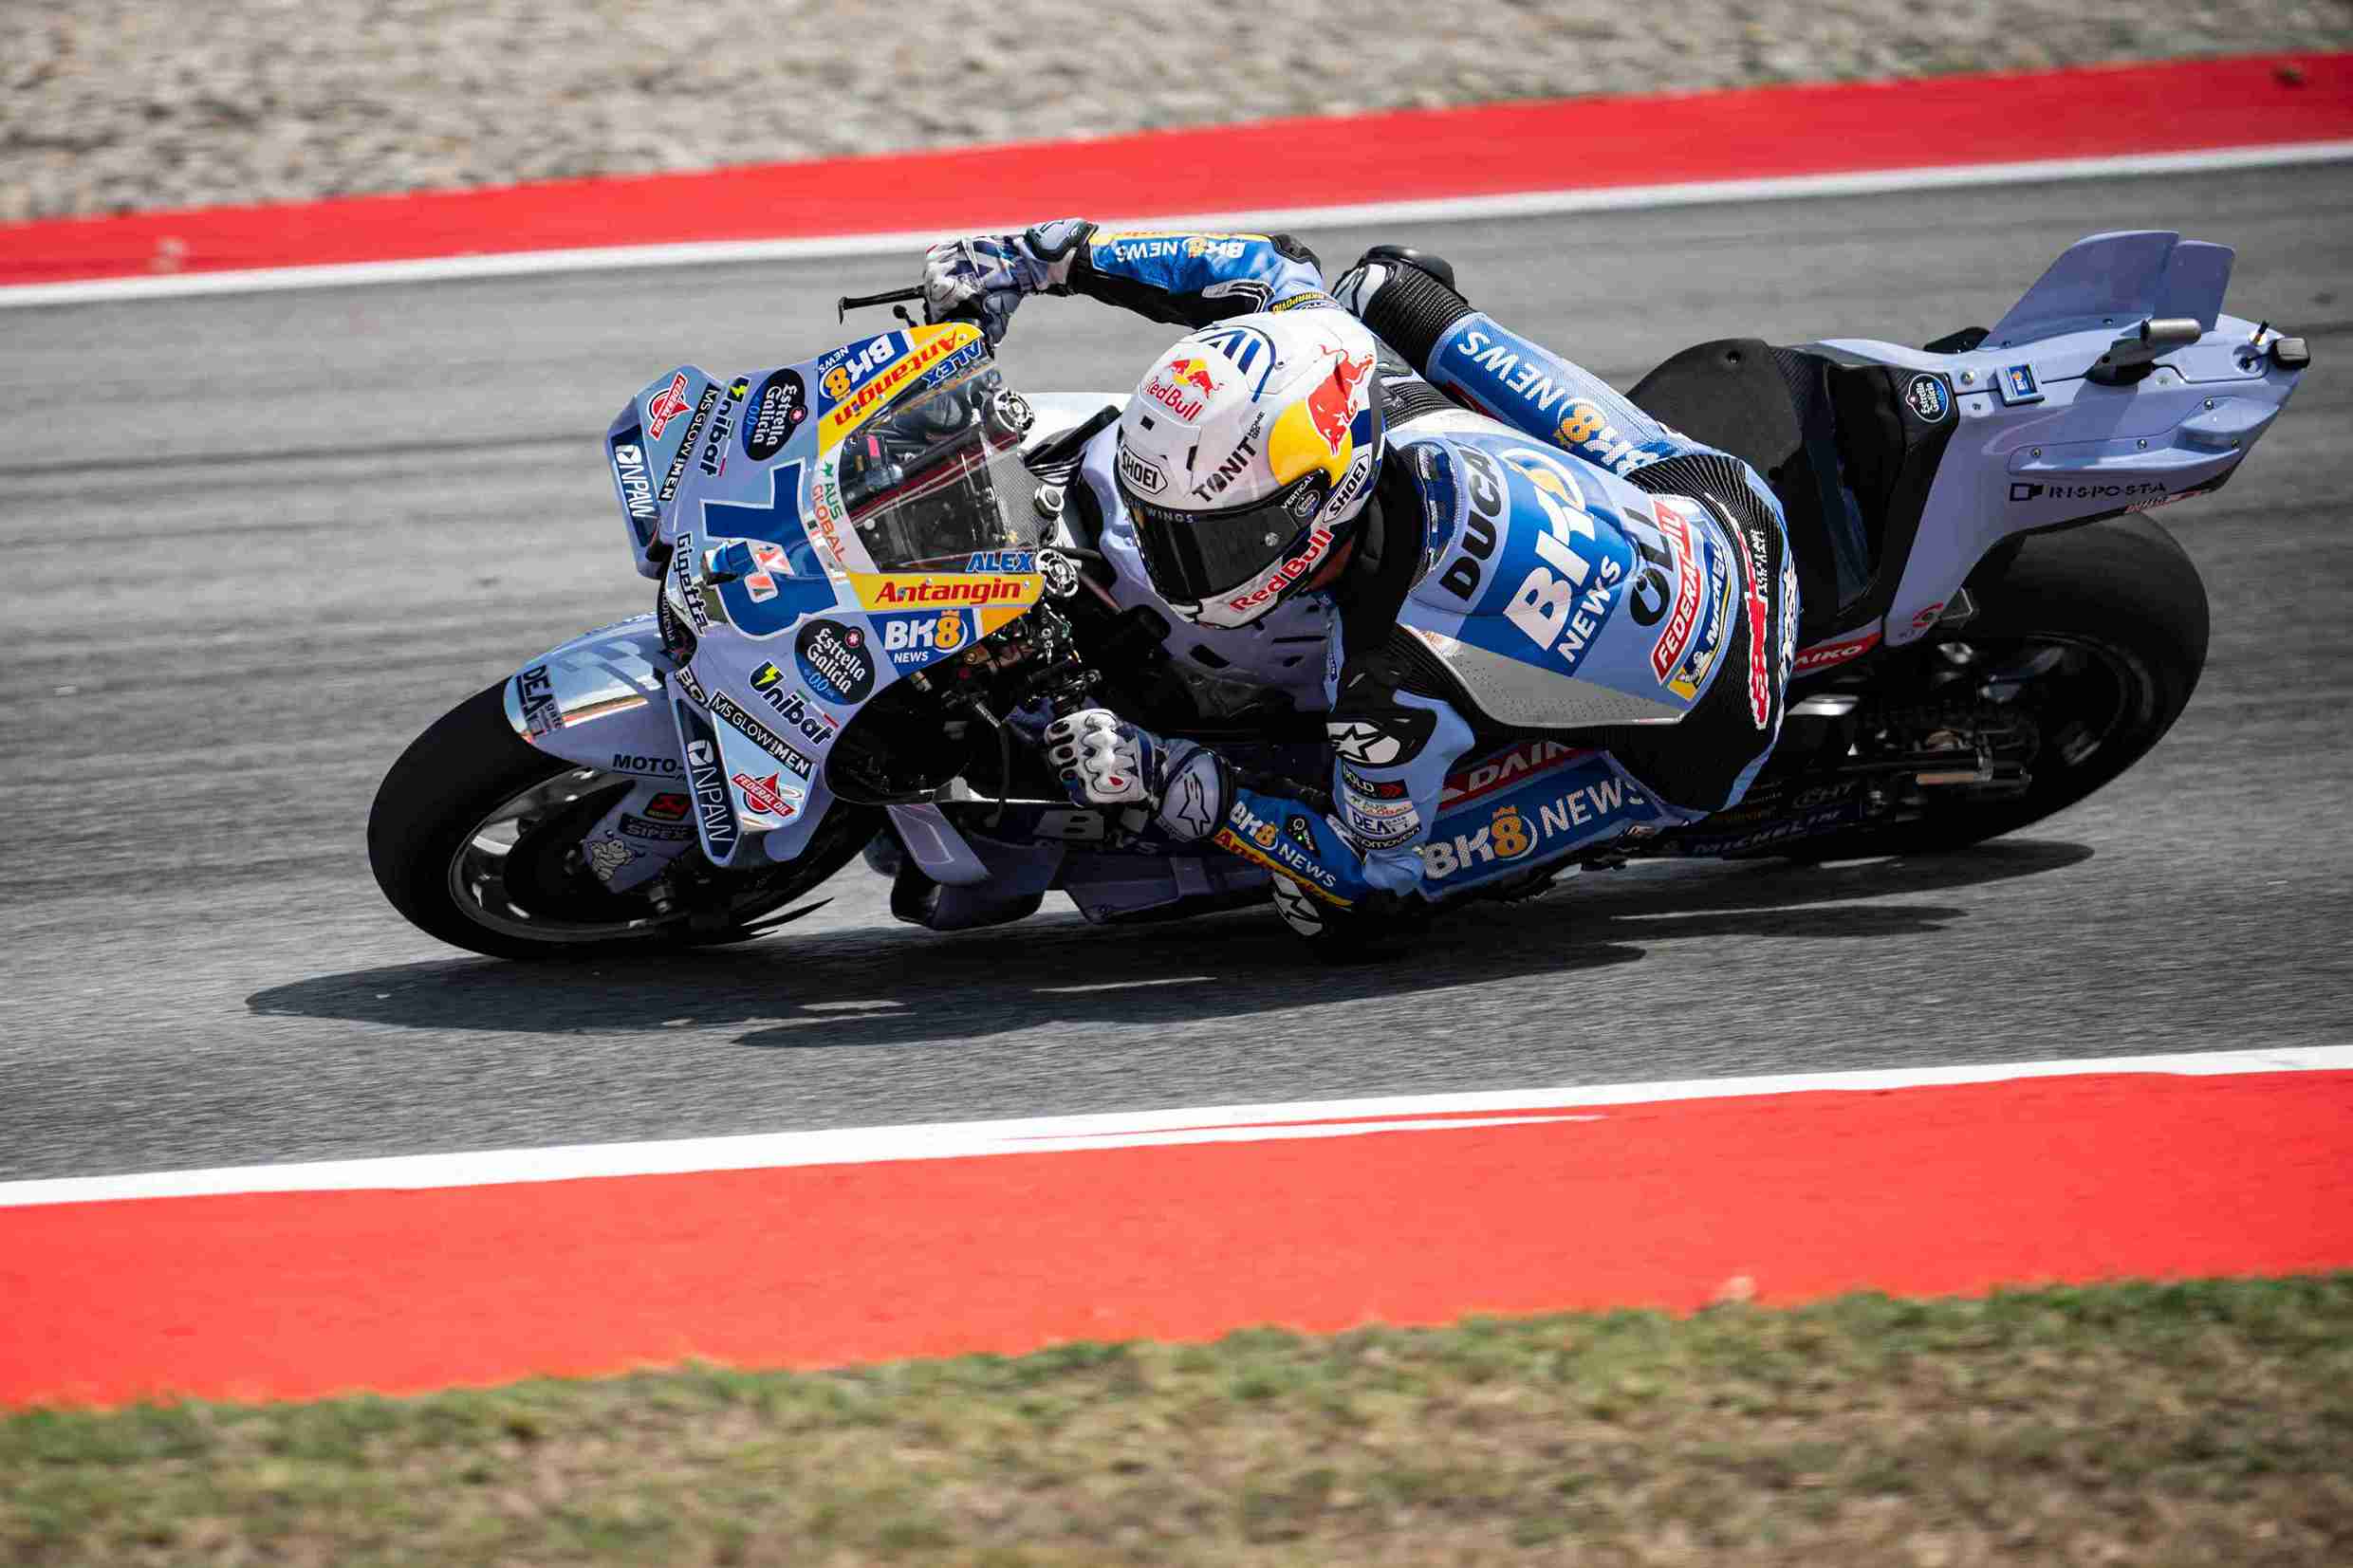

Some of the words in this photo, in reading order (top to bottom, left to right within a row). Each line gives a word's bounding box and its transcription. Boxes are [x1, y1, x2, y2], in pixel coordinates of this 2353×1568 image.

[1116, 242, 1177, 262] NEWS
[820, 346, 849, 373] NEWS
[824, 335, 896, 398] BK8
[834, 331, 957, 426] Antangin
[922, 341, 982, 389] ALEX
[1457, 332, 1565, 412] NEWS
[700, 389, 718, 412] MS
[752, 386, 783, 444] Galicia
[767, 383, 798, 447] Estrella
[1162, 388, 1202, 421] Bull
[682, 412, 703, 458] GLOW
[621, 463, 655, 519] NPAW
[661, 462, 685, 500] MEN
[1121, 451, 1158, 490] SHOEI
[1329, 460, 1368, 516] SHOEI
[2048, 481, 2167, 500] RISPOSTA
[824, 482, 843, 522] AUS
[673, 531, 710, 637] Gigetta
[966, 551, 1036, 574] ALEX
[1230, 572, 1288, 612] Red
[1281, 527, 1334, 580] Bull
[875, 578, 1022, 605] Antangin
[1557, 555, 1621, 664] NEWS
[1657, 556, 1699, 669] FEDERAL
[815, 627, 866, 682] Estrella
[884, 615, 962, 653] BK8
[894, 652, 930, 665] NEWS
[806, 642, 853, 694] Galicia
[713, 697, 734, 721] MS
[732, 708, 774, 751] GLOW
[774, 745, 811, 776] MEN
[692, 766, 734, 843] NPAW
[735, 774, 775, 806] FEDERAL
[772, 798, 795, 818] OIL
[1230, 802, 1277, 847] BK8
[1279, 843, 1337, 889] NEWS
[1423, 814, 1530, 879] BK8
